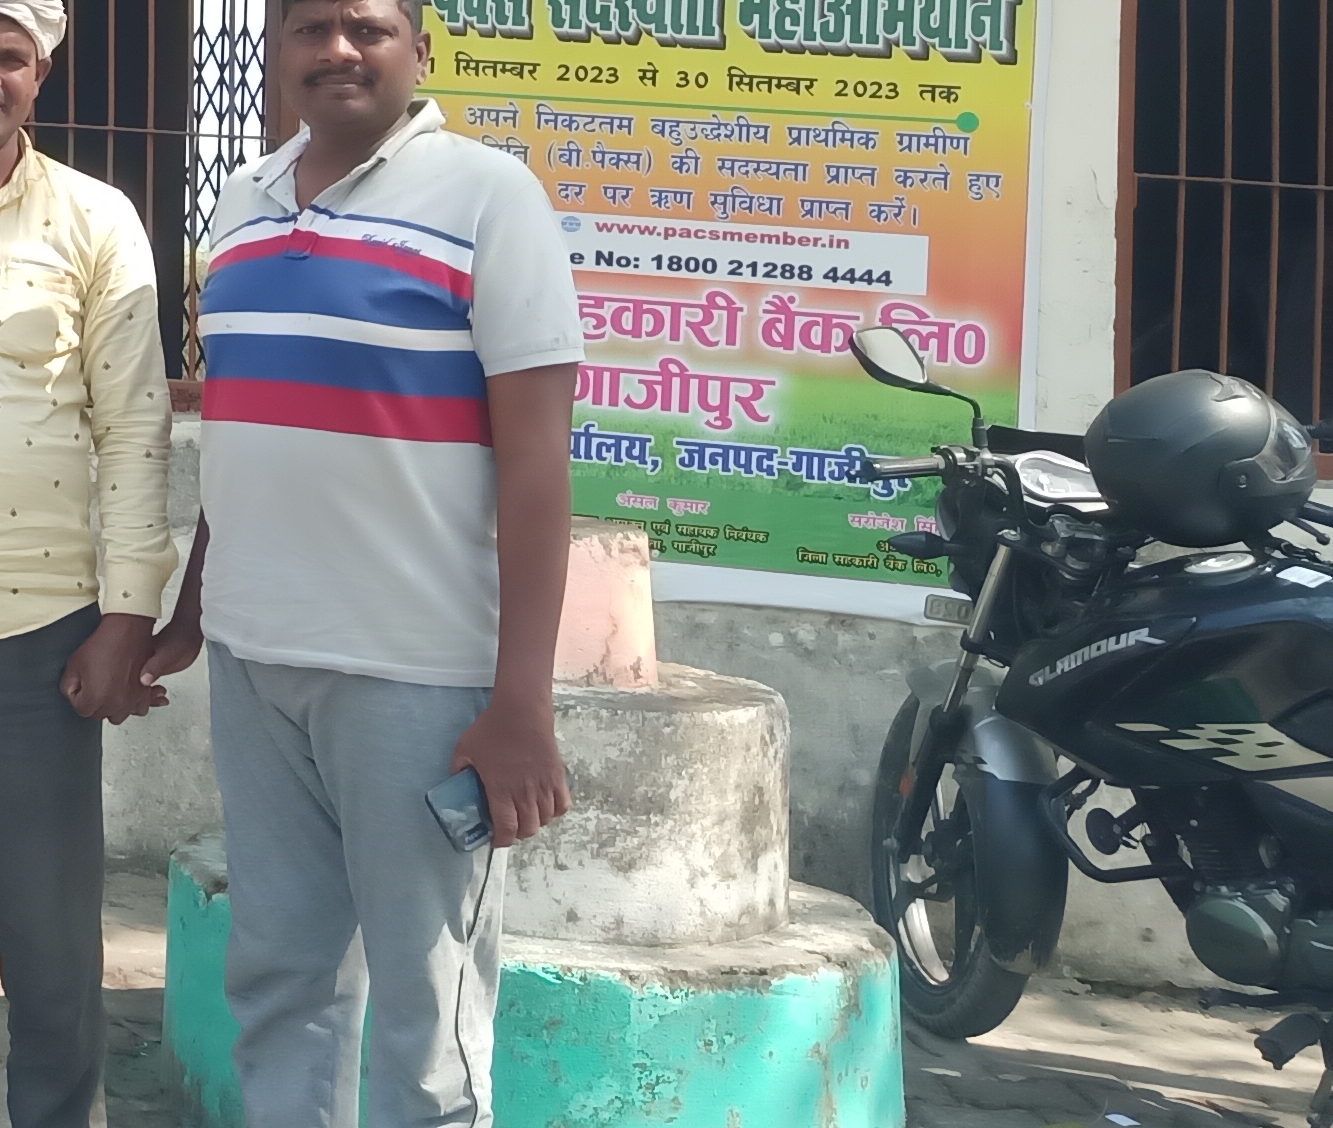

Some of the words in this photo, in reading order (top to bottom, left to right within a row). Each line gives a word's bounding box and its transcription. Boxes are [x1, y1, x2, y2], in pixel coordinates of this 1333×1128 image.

[454, 51, 541, 81] सितम्बर
[557, 64, 620, 84] 2023
[637, 62, 659, 87] से
[676, 71, 709, 89] 30
[727, 65, 817, 97] सितम्बर
[834, 79, 900, 100] 2023
[918, 83, 961, 105] तक
[467, 102, 519, 129] अपने
[536, 103, 633, 136] निकटतम
[787, 120, 879, 150] प्राथमिक
[896, 126, 970, 156] ग्रामीण
[670, 147, 701, 175] की
[717, 157, 808, 182] सदस्यता
[825, 163, 877, 187] प्राप्त
[894, 163, 950, 191] करते
[968, 172, 1002, 199] हुए
[557, 182, 586, 204] दर
[602, 185, 633, 206] पर
[649, 188, 693, 210] ऋण
[709, 186, 783, 220] सुविधा
[800, 198, 851, 221] प्राप्त
[594, 220, 851, 250] www.pacsmember.in
[595, 250, 640, 270] No:
[650, 254, 718, 274] 1800
[727, 259, 814, 282] 21288
[822, 266, 893, 288] 4444
[577, 290, 744, 348] हकारी
[761, 294, 861, 354] बैंक
[668, 498, 710, 515] कुमार
